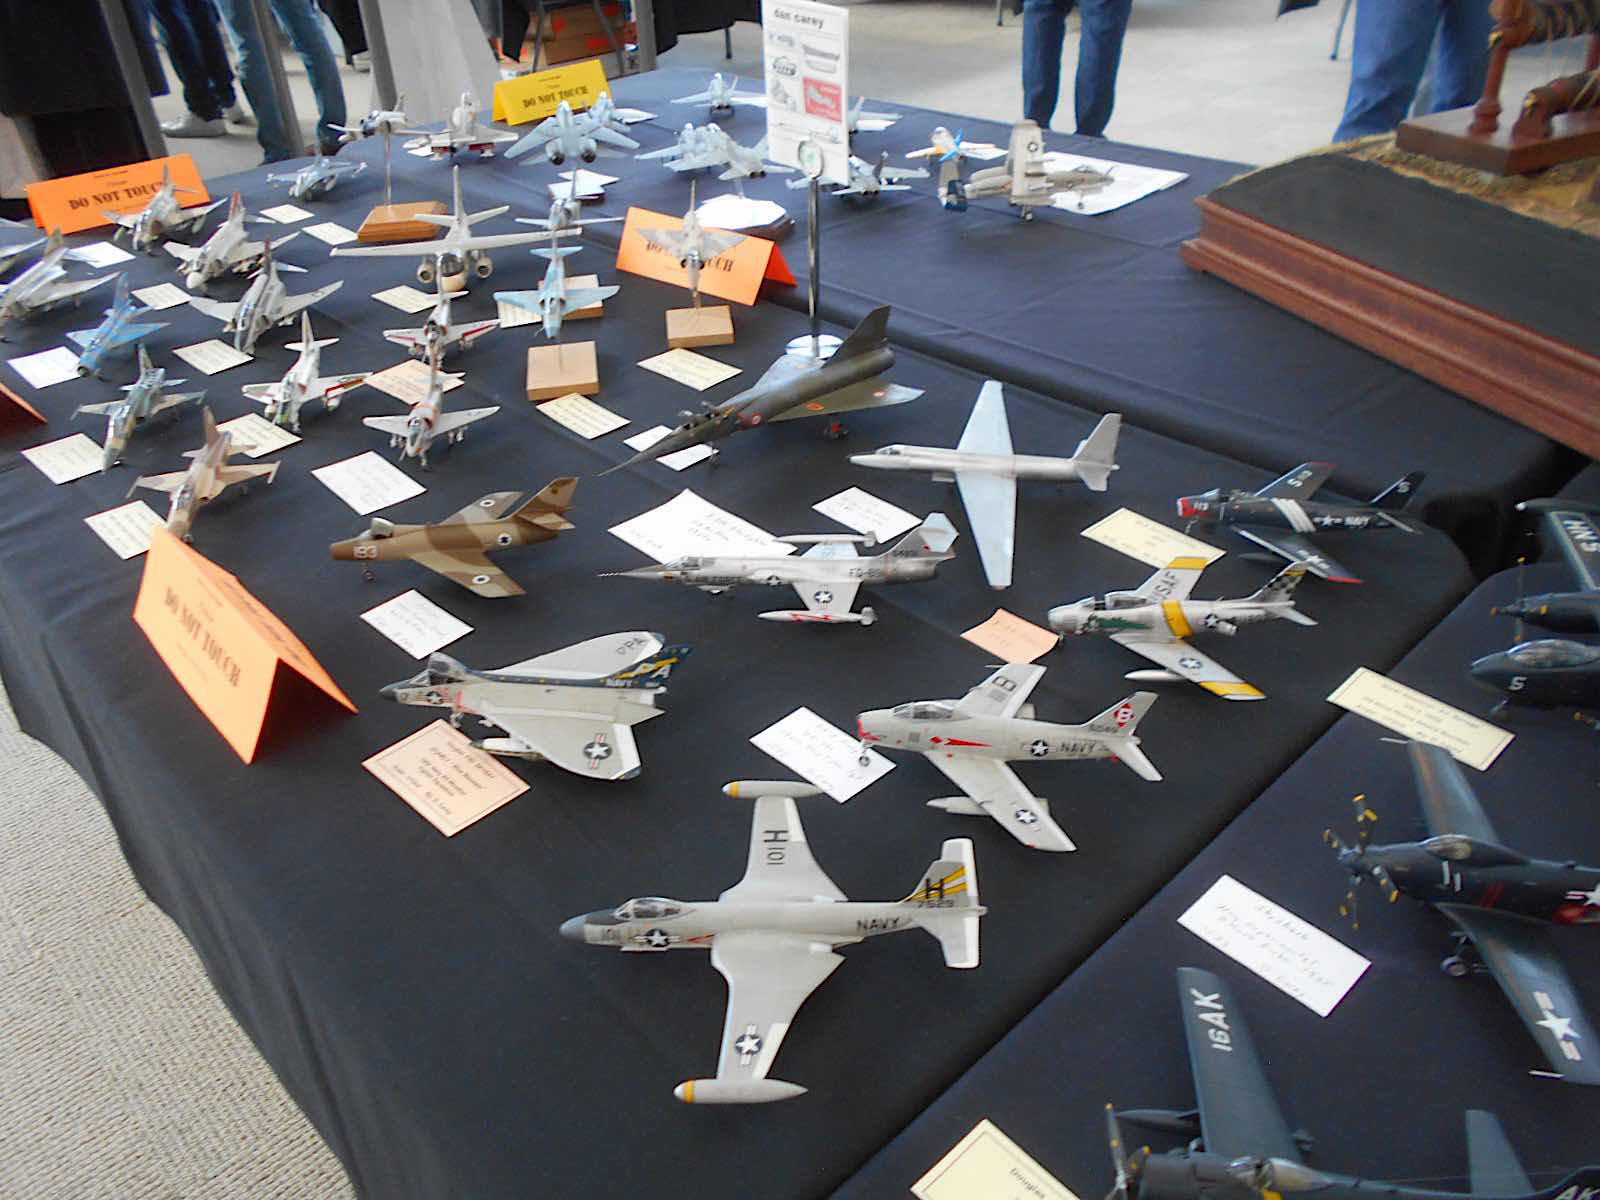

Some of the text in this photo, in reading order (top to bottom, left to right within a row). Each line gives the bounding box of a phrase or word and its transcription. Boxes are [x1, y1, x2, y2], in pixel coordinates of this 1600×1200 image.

[68, 197, 90, 210] DO
[92, 189, 121, 205] NOT
[124, 180, 163, 199] TOUC
[1060, 742, 1097, 754] NAVY
[763, 830, 789, 843] H
[926, 878, 945, 899] H
[857, 916, 900, 930] NAVY
[1189, 987, 1233, 1053] 16AK
